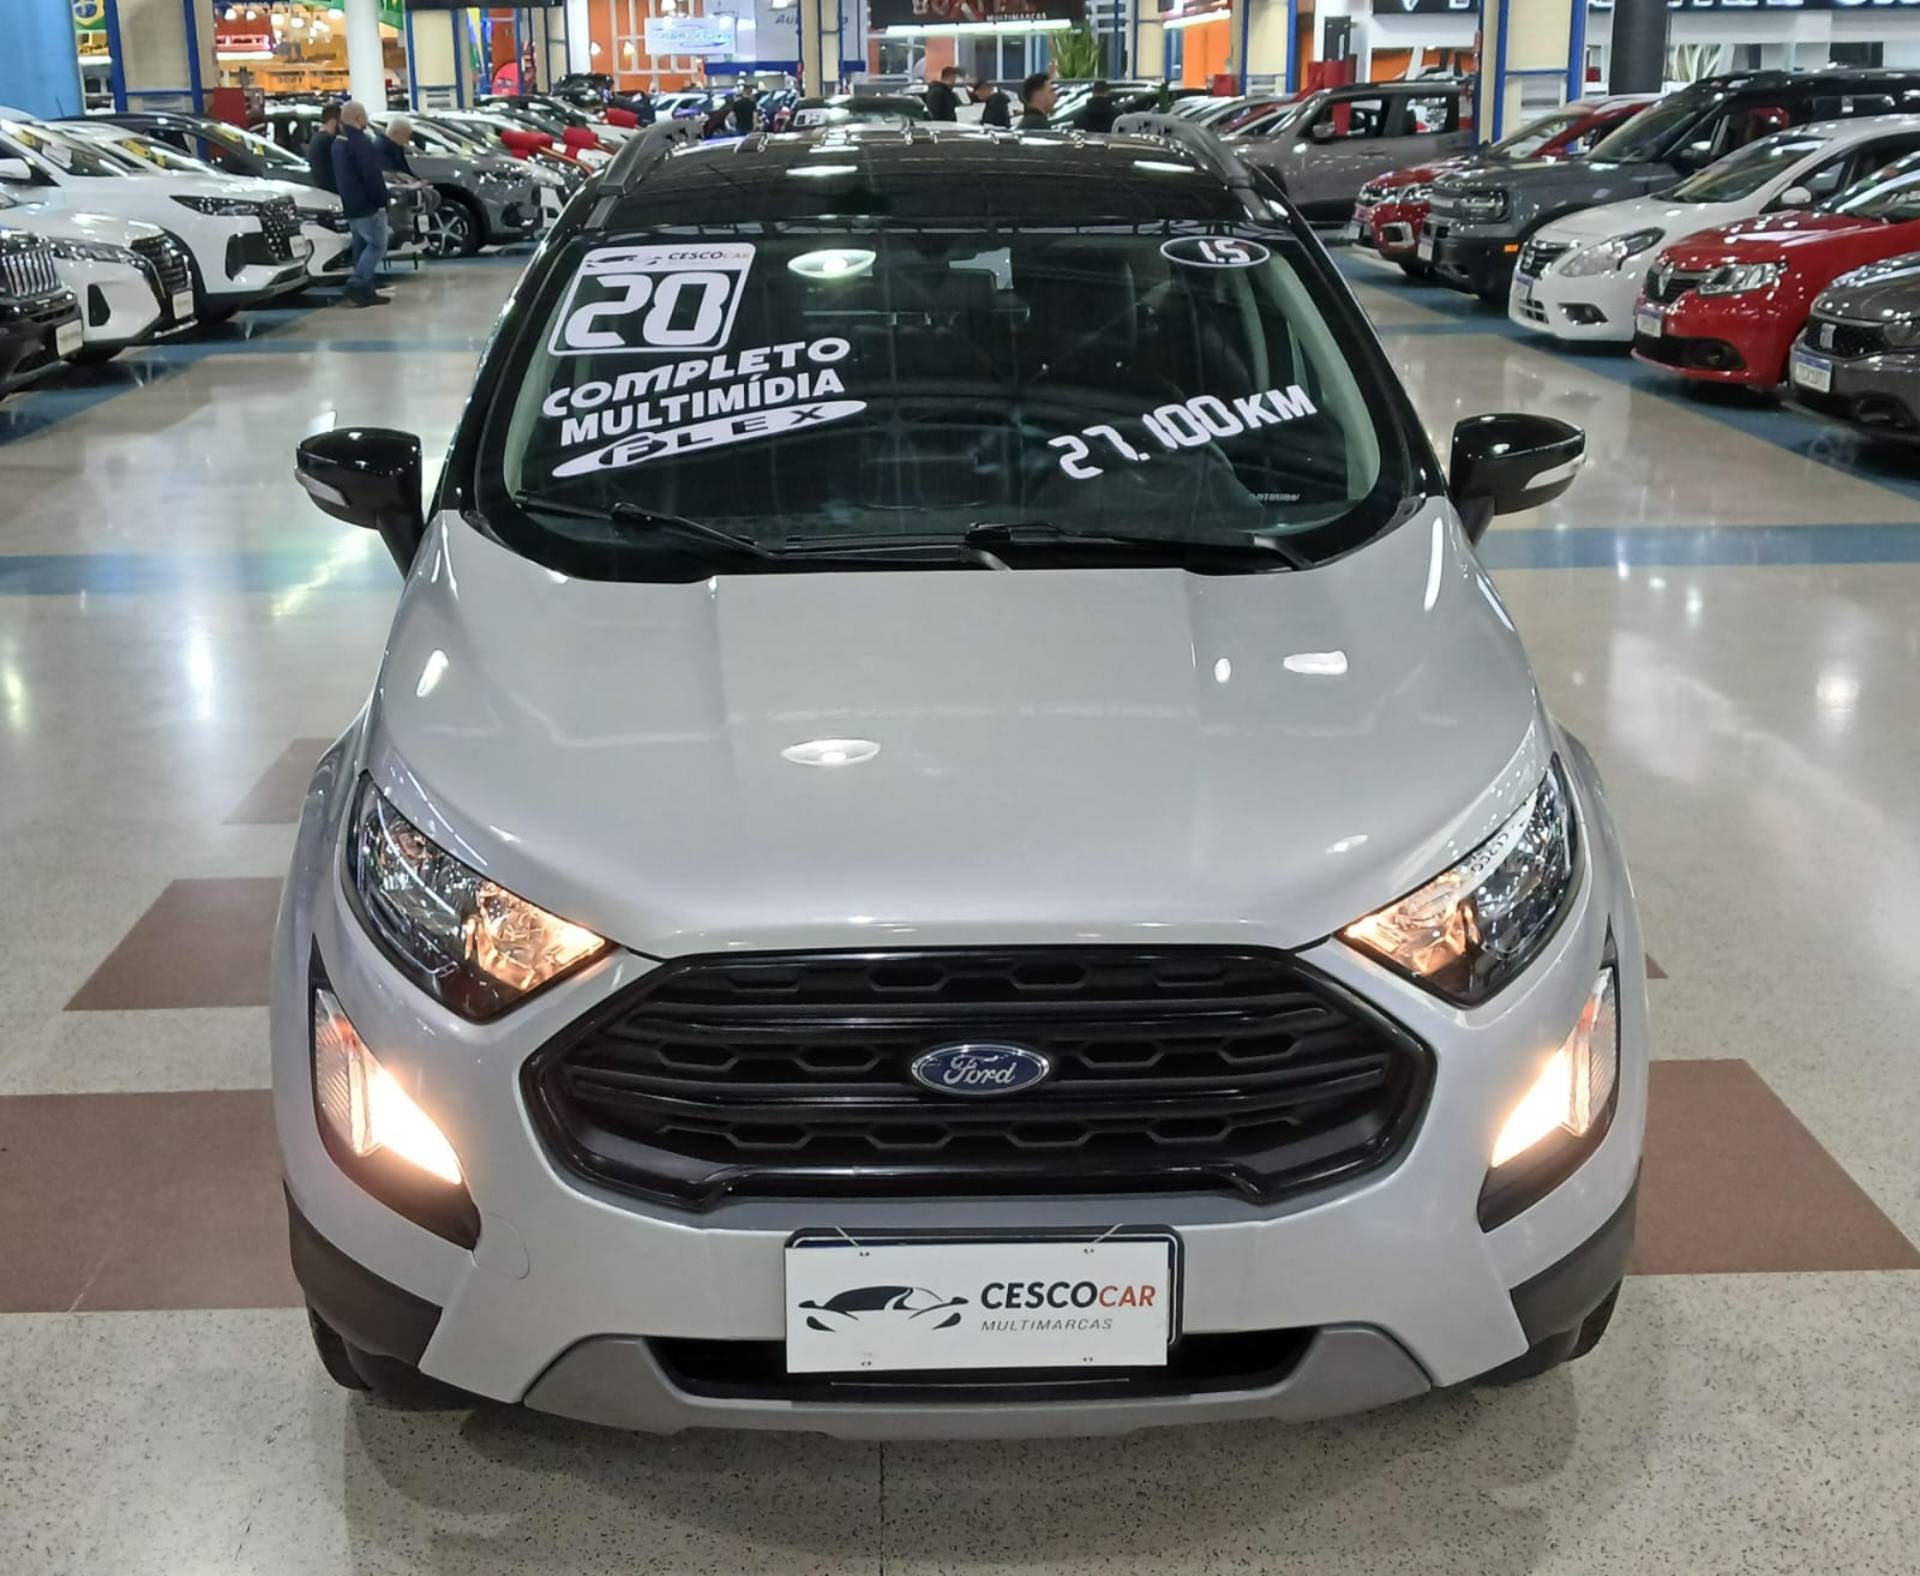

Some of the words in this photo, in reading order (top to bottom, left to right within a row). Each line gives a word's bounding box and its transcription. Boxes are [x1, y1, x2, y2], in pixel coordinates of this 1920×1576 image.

[1198, 240, 1250, 262] 1.5
[565, 271, 731, 349] 20
[542, 337, 851, 417] COMPLETO
[561, 368, 845, 446] MULTIMÍDIA
[599, 405, 828, 468] FLEX
[943, 1054, 1018, 1085] Ford
[980, 1281, 1156, 1310] CESCOCAR
[980, 1318, 1113, 1332] MULTIMARCAS
